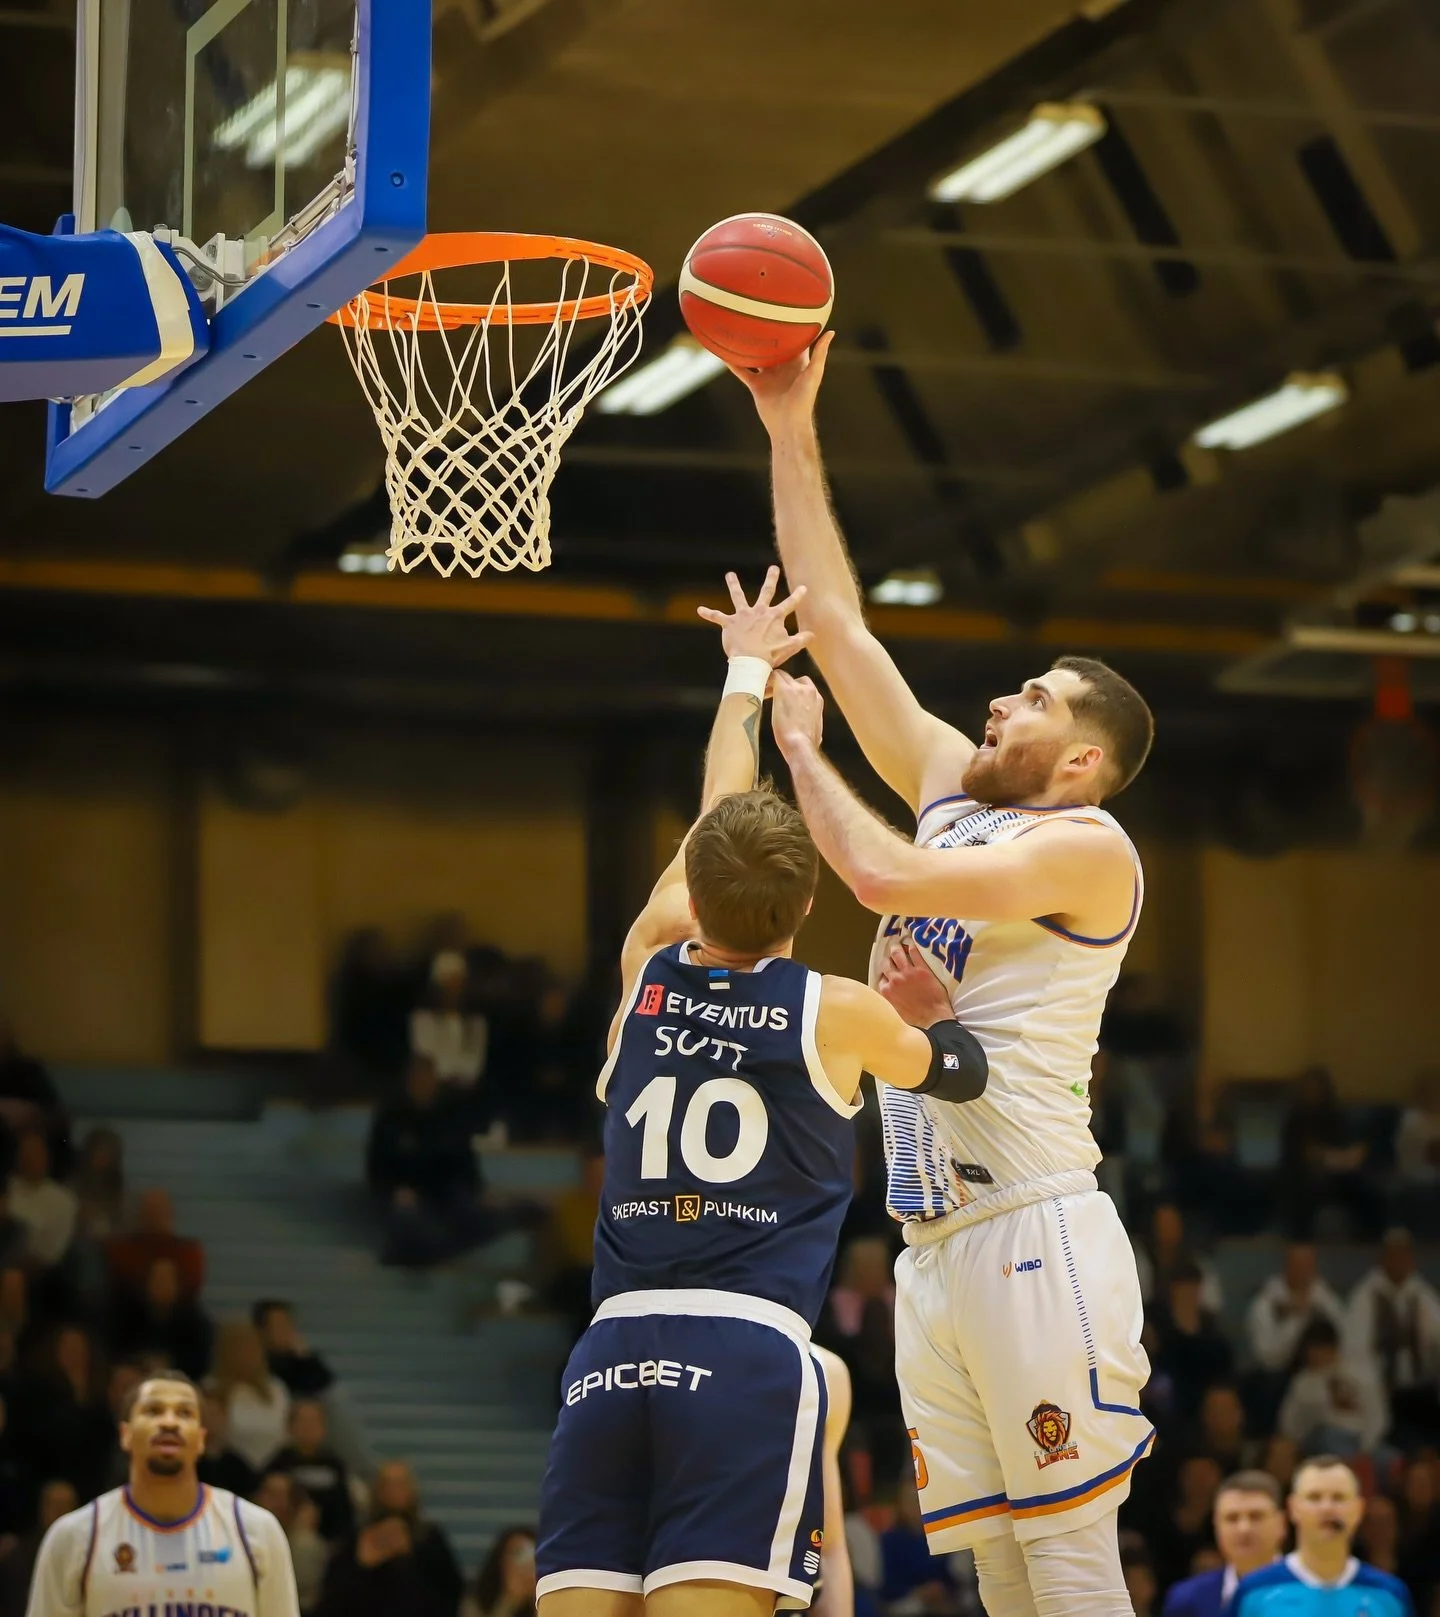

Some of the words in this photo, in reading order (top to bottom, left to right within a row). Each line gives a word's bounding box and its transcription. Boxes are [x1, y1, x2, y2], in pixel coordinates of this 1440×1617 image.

[666, 991, 789, 1031] EVENTUS
[625, 1076, 768, 1183] 10
[611, 1201, 671, 1220] SKEPAST
[703, 1201, 778, 1224] PUHKIM
[1014, 1258, 1042, 1273] WIBO
[566, 1359, 712, 1406] EPICBET
